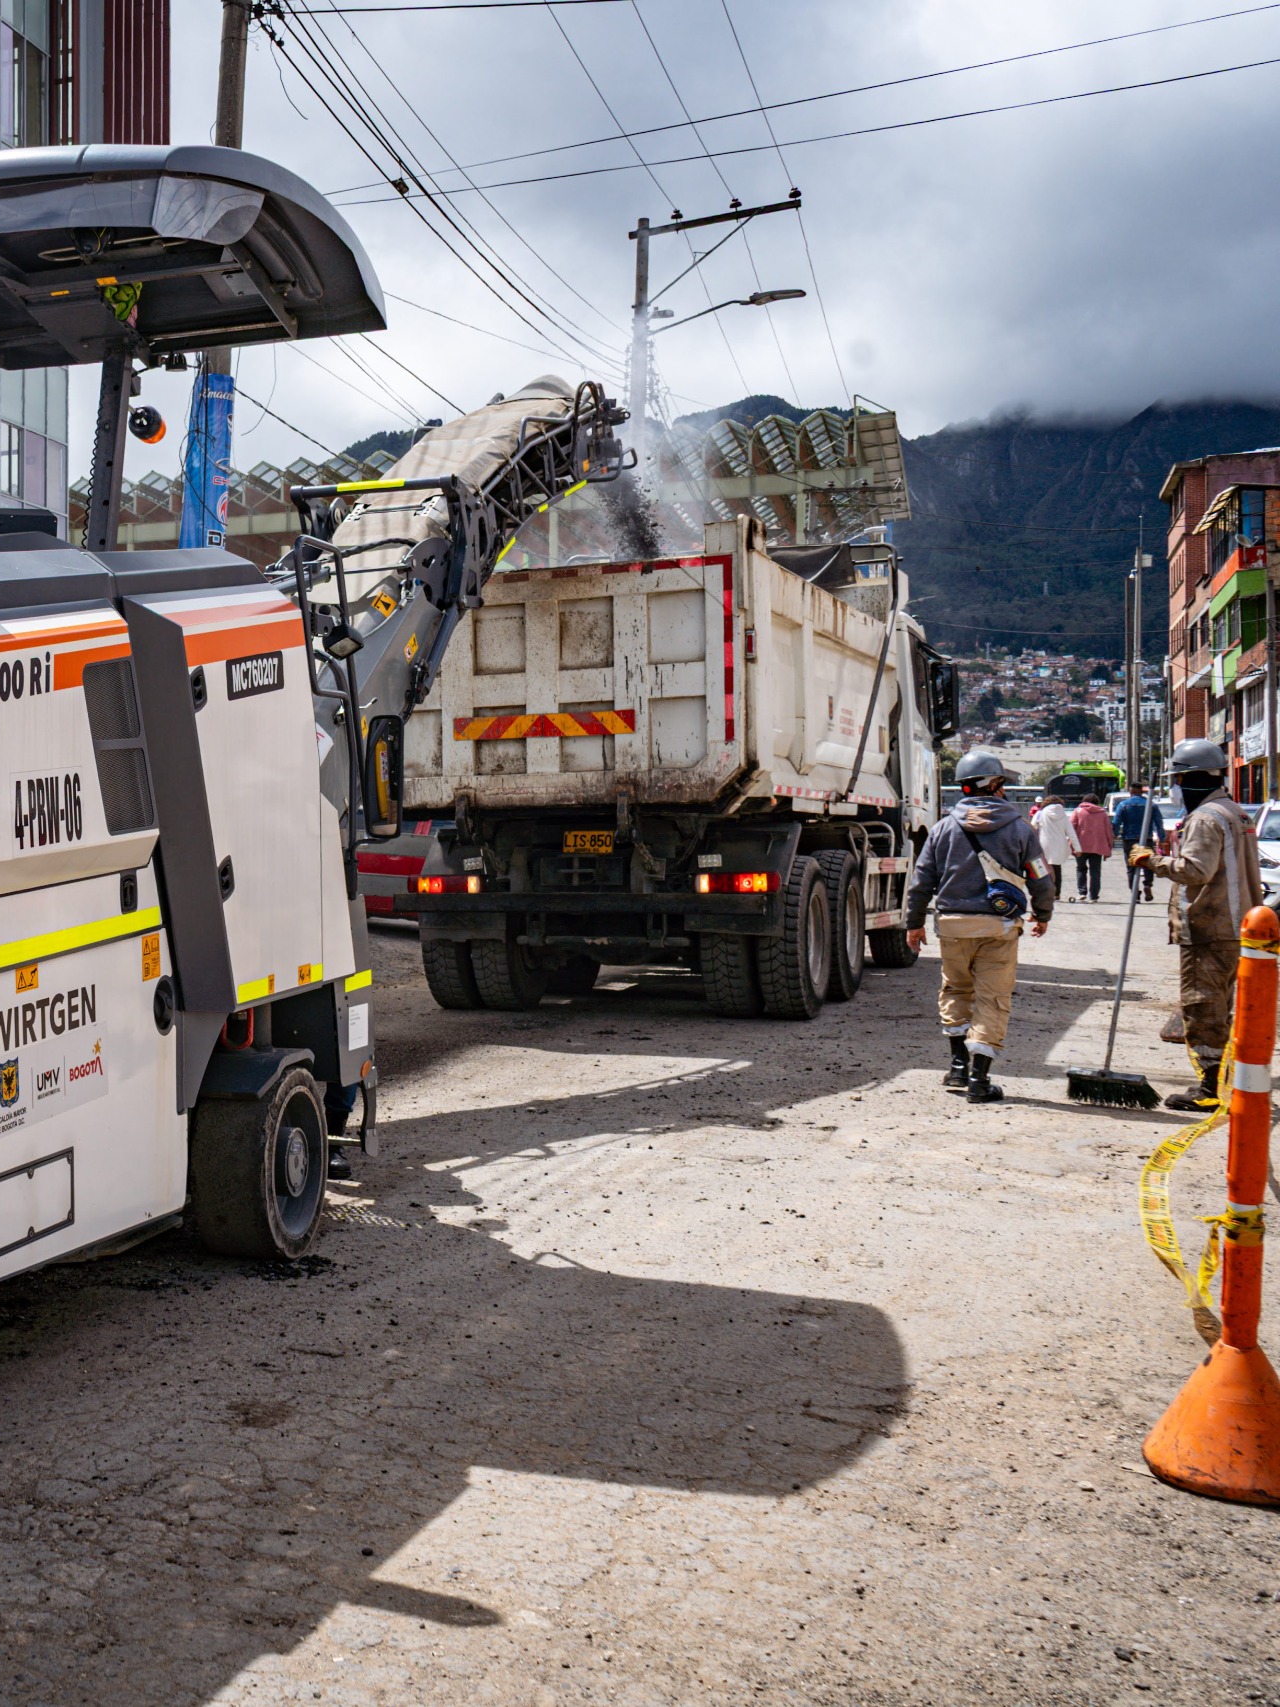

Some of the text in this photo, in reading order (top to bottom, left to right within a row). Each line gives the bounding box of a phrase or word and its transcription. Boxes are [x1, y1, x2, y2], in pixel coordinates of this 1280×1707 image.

[30, 651, 52, 695] Ri
[231, 656, 279, 693] MC760207
[15, 772, 83, 850] 4-PBW-06
[36, 1067, 61, 1092] UMV
